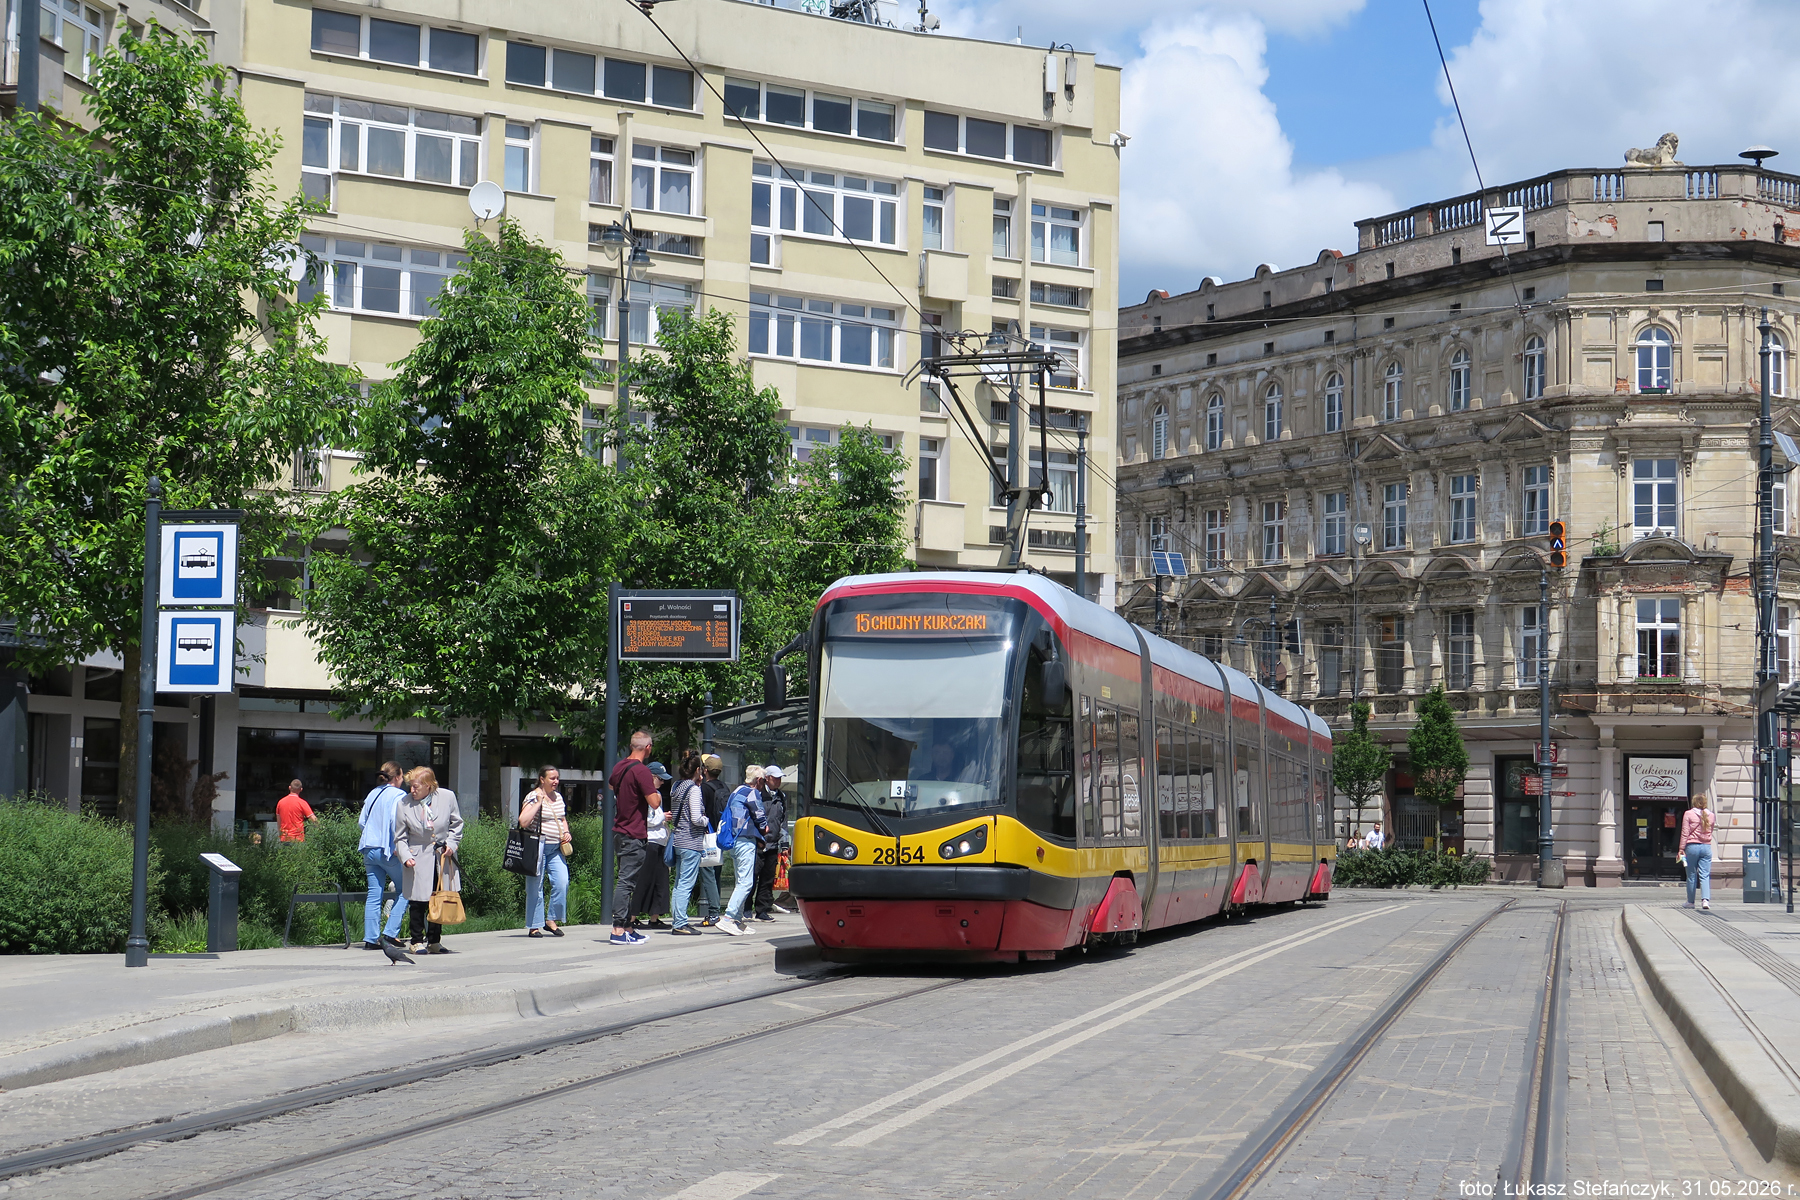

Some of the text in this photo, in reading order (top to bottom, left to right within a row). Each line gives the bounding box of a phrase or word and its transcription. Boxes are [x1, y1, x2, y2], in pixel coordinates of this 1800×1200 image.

[658, 604, 666, 612] pl.
[855, 613, 987, 633] 15 CHOJNY KURCZAKI
[1630, 763, 1685, 776] Cukiernia
[896, 786, 902, 796] 3
[873, 846, 926, 865] 2854
